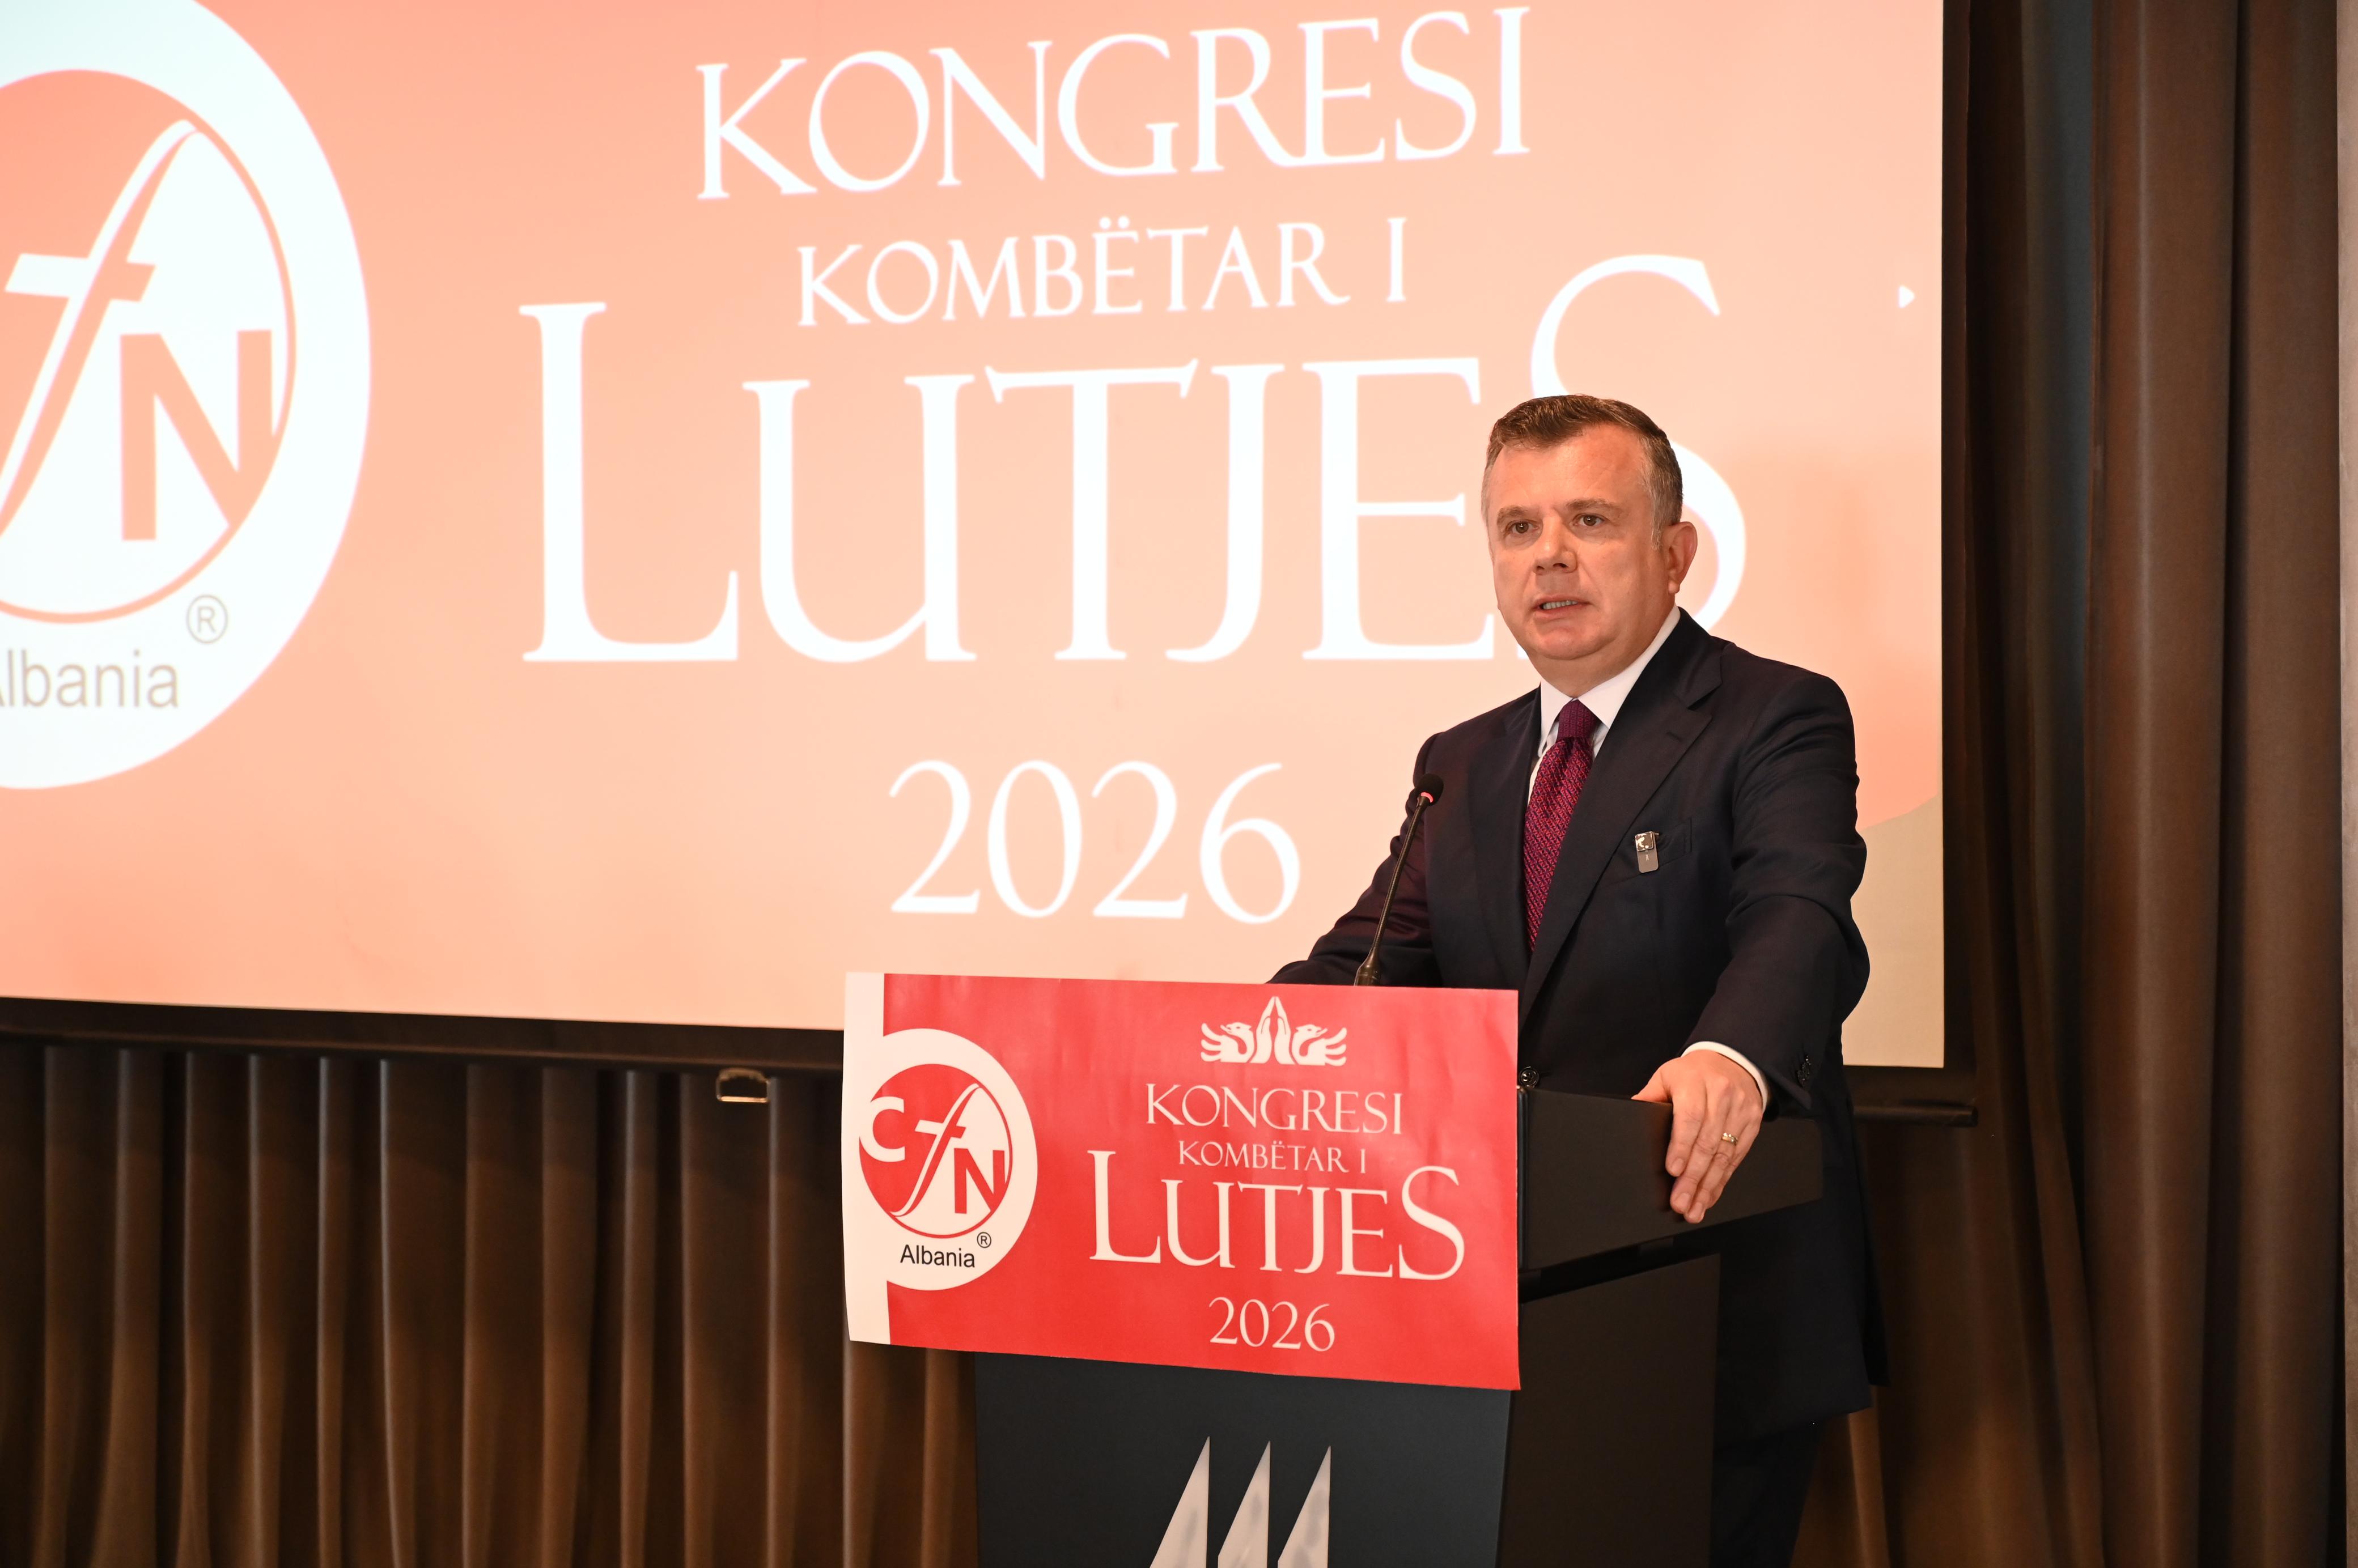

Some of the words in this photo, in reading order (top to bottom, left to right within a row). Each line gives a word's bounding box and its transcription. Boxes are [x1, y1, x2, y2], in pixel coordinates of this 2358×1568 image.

[697, 6, 1531, 199] KONGRESI
[797, 216, 1351, 326] KOMBËTAR
[1386, 217, 1407, 303] I
[0, 648, 179, 709] lbania
[890, 759, 1301, 923] 2026
[1146, 1083, 1402, 1134] KONGRESI
[1178, 1140, 1348, 1174] KOMBËTAR
[1360, 1148, 1367, 1174] I
[1087, 1150, 1465, 1280] LUTJES
[900, 1244, 976, 1268] Albania
[1208, 1297, 1335, 1352] 2026
